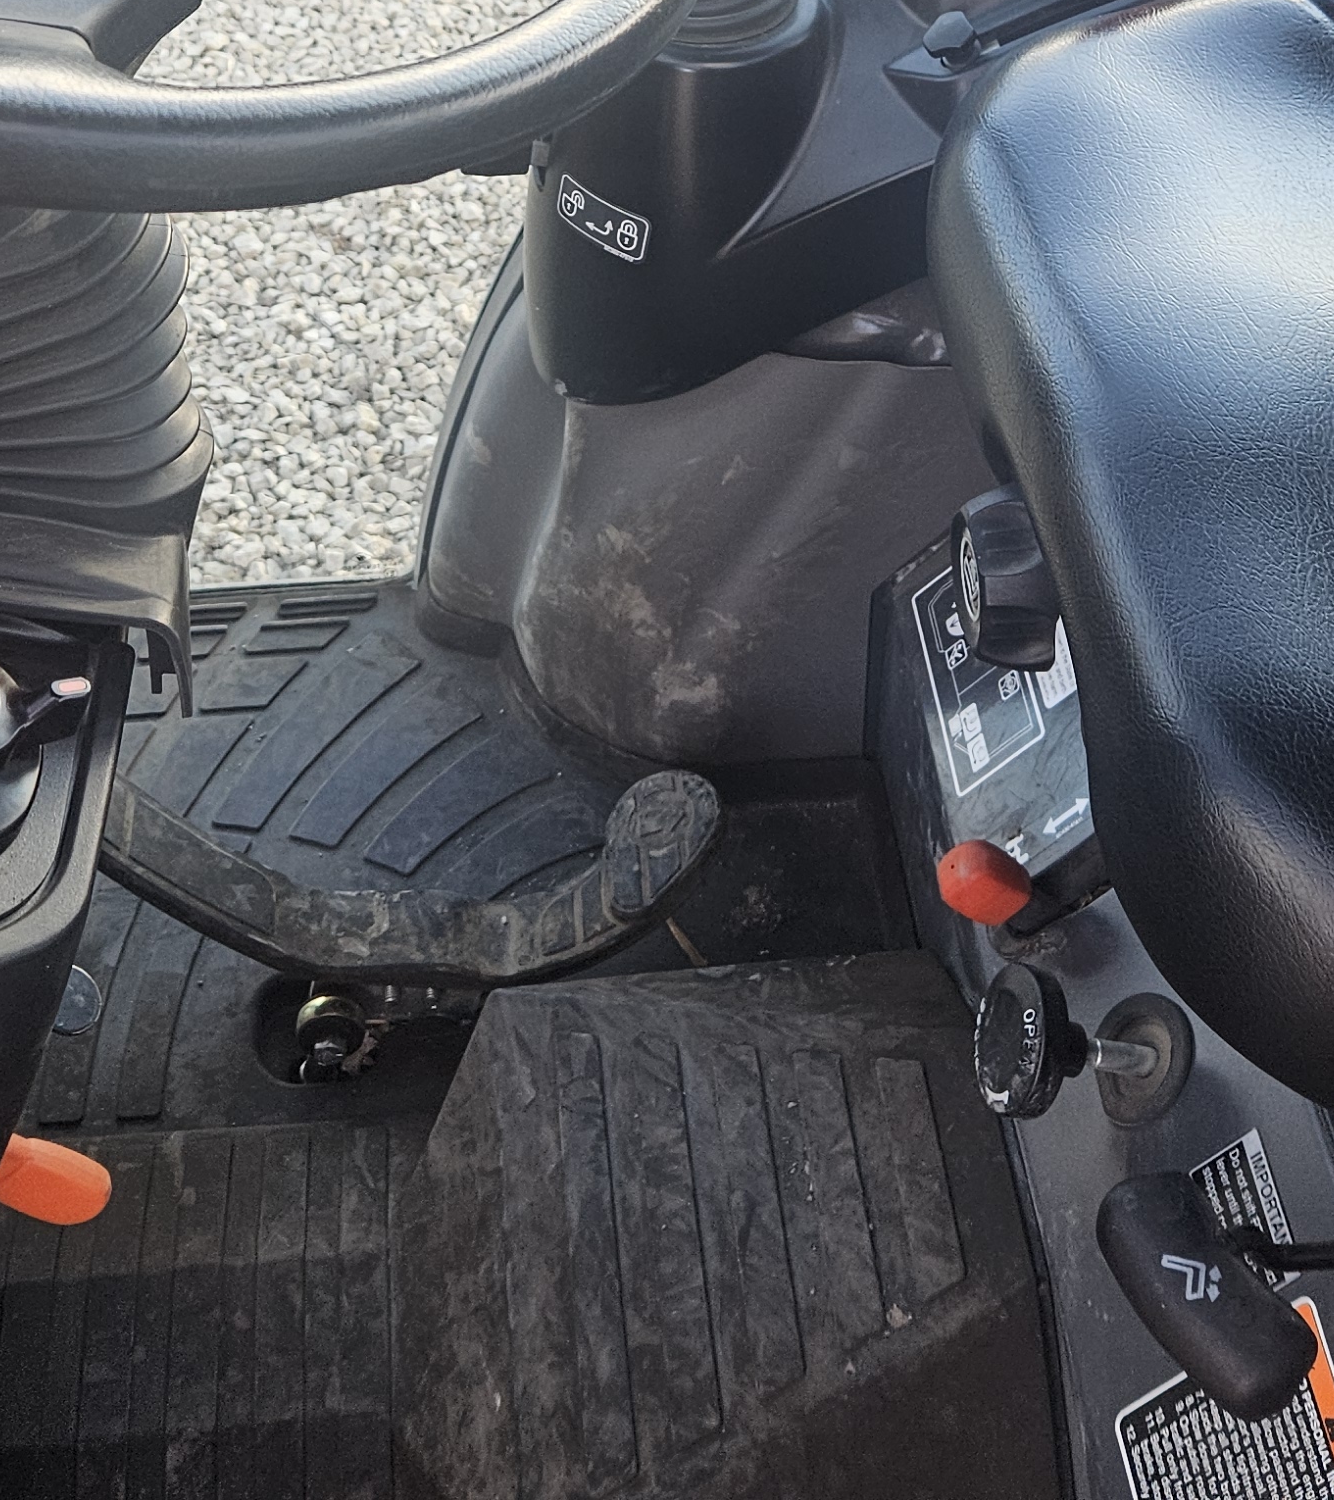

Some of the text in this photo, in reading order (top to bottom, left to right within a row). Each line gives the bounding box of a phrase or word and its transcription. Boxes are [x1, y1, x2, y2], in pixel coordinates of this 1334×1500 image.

[1019, 1009, 1037, 1074] OPEN
[1215, 1156, 1230, 1186] lever
[1224, 1187, 1240, 1215] until
[1228, 1147, 1240, 1168] Do
[1235, 1167, 1248, 1190] not
[1250, 1151, 1289, 1245] IMPORTAN
[1179, 1414, 1189, 1436] On
[1194, 1474, 1209, 1500] roa
[1282, 1406, 1316, 1500] tarting the engi
[1295, 1413, 1325, 1486] understand
[1301, 1389, 1331, 1471] PERSONAL
[1173, 1479, 1185, 1500] fro
[1220, 1479, 1231, 1500] bra
[1222, 1448, 1240, 1494] shields
[1265, 1473, 1279, 1500] othe
[1268, 1448, 1292, 1500] passeng
[1285, 1460, 1300, 1486] and
